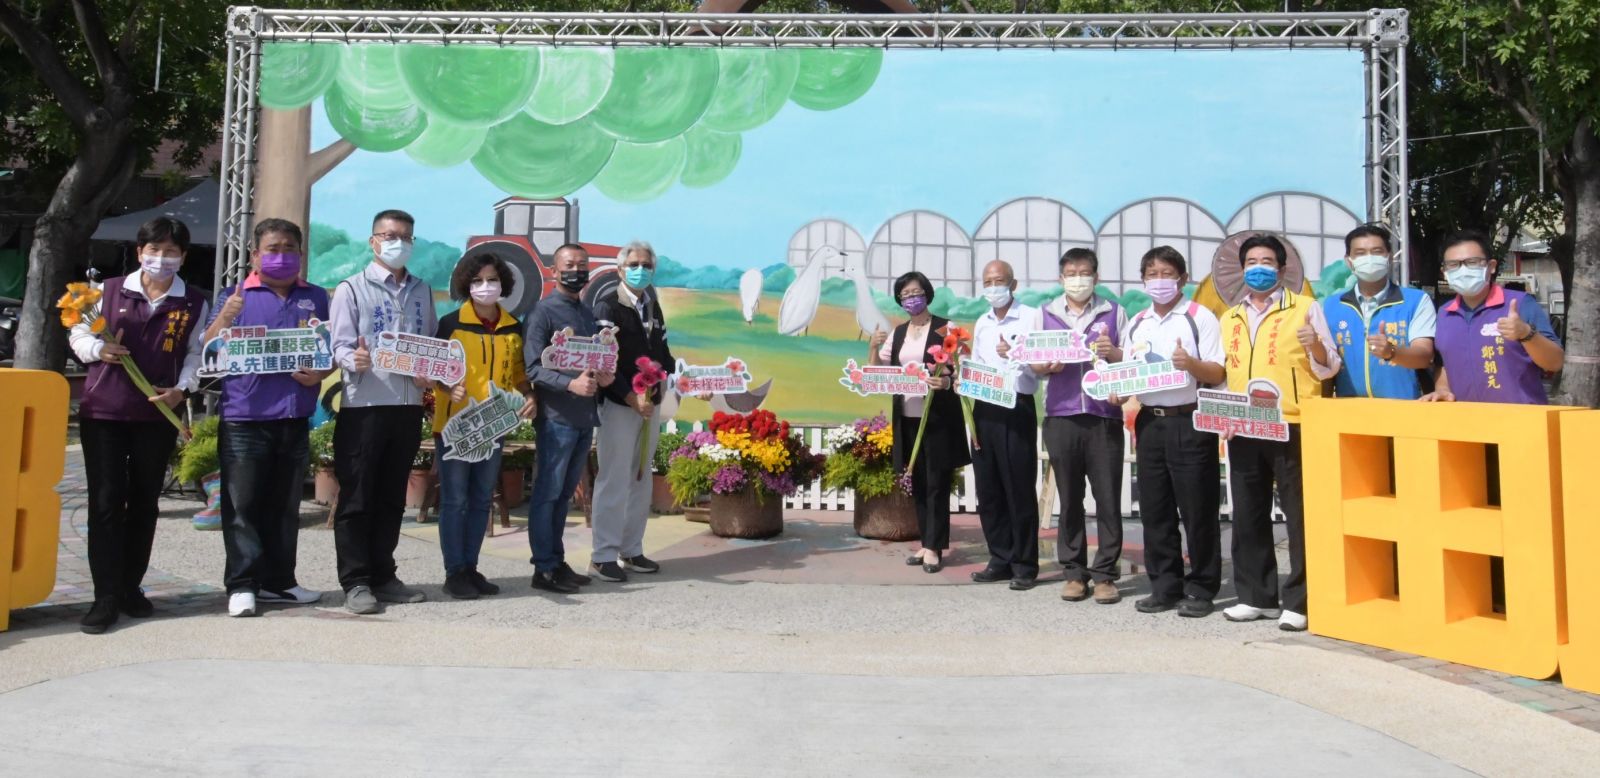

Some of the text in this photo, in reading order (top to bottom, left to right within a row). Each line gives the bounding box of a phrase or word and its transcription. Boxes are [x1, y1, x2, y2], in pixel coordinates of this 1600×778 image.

[228, 337, 315, 355] 新品種發表
[1195, 414, 1286, 439] 體驗式採果
